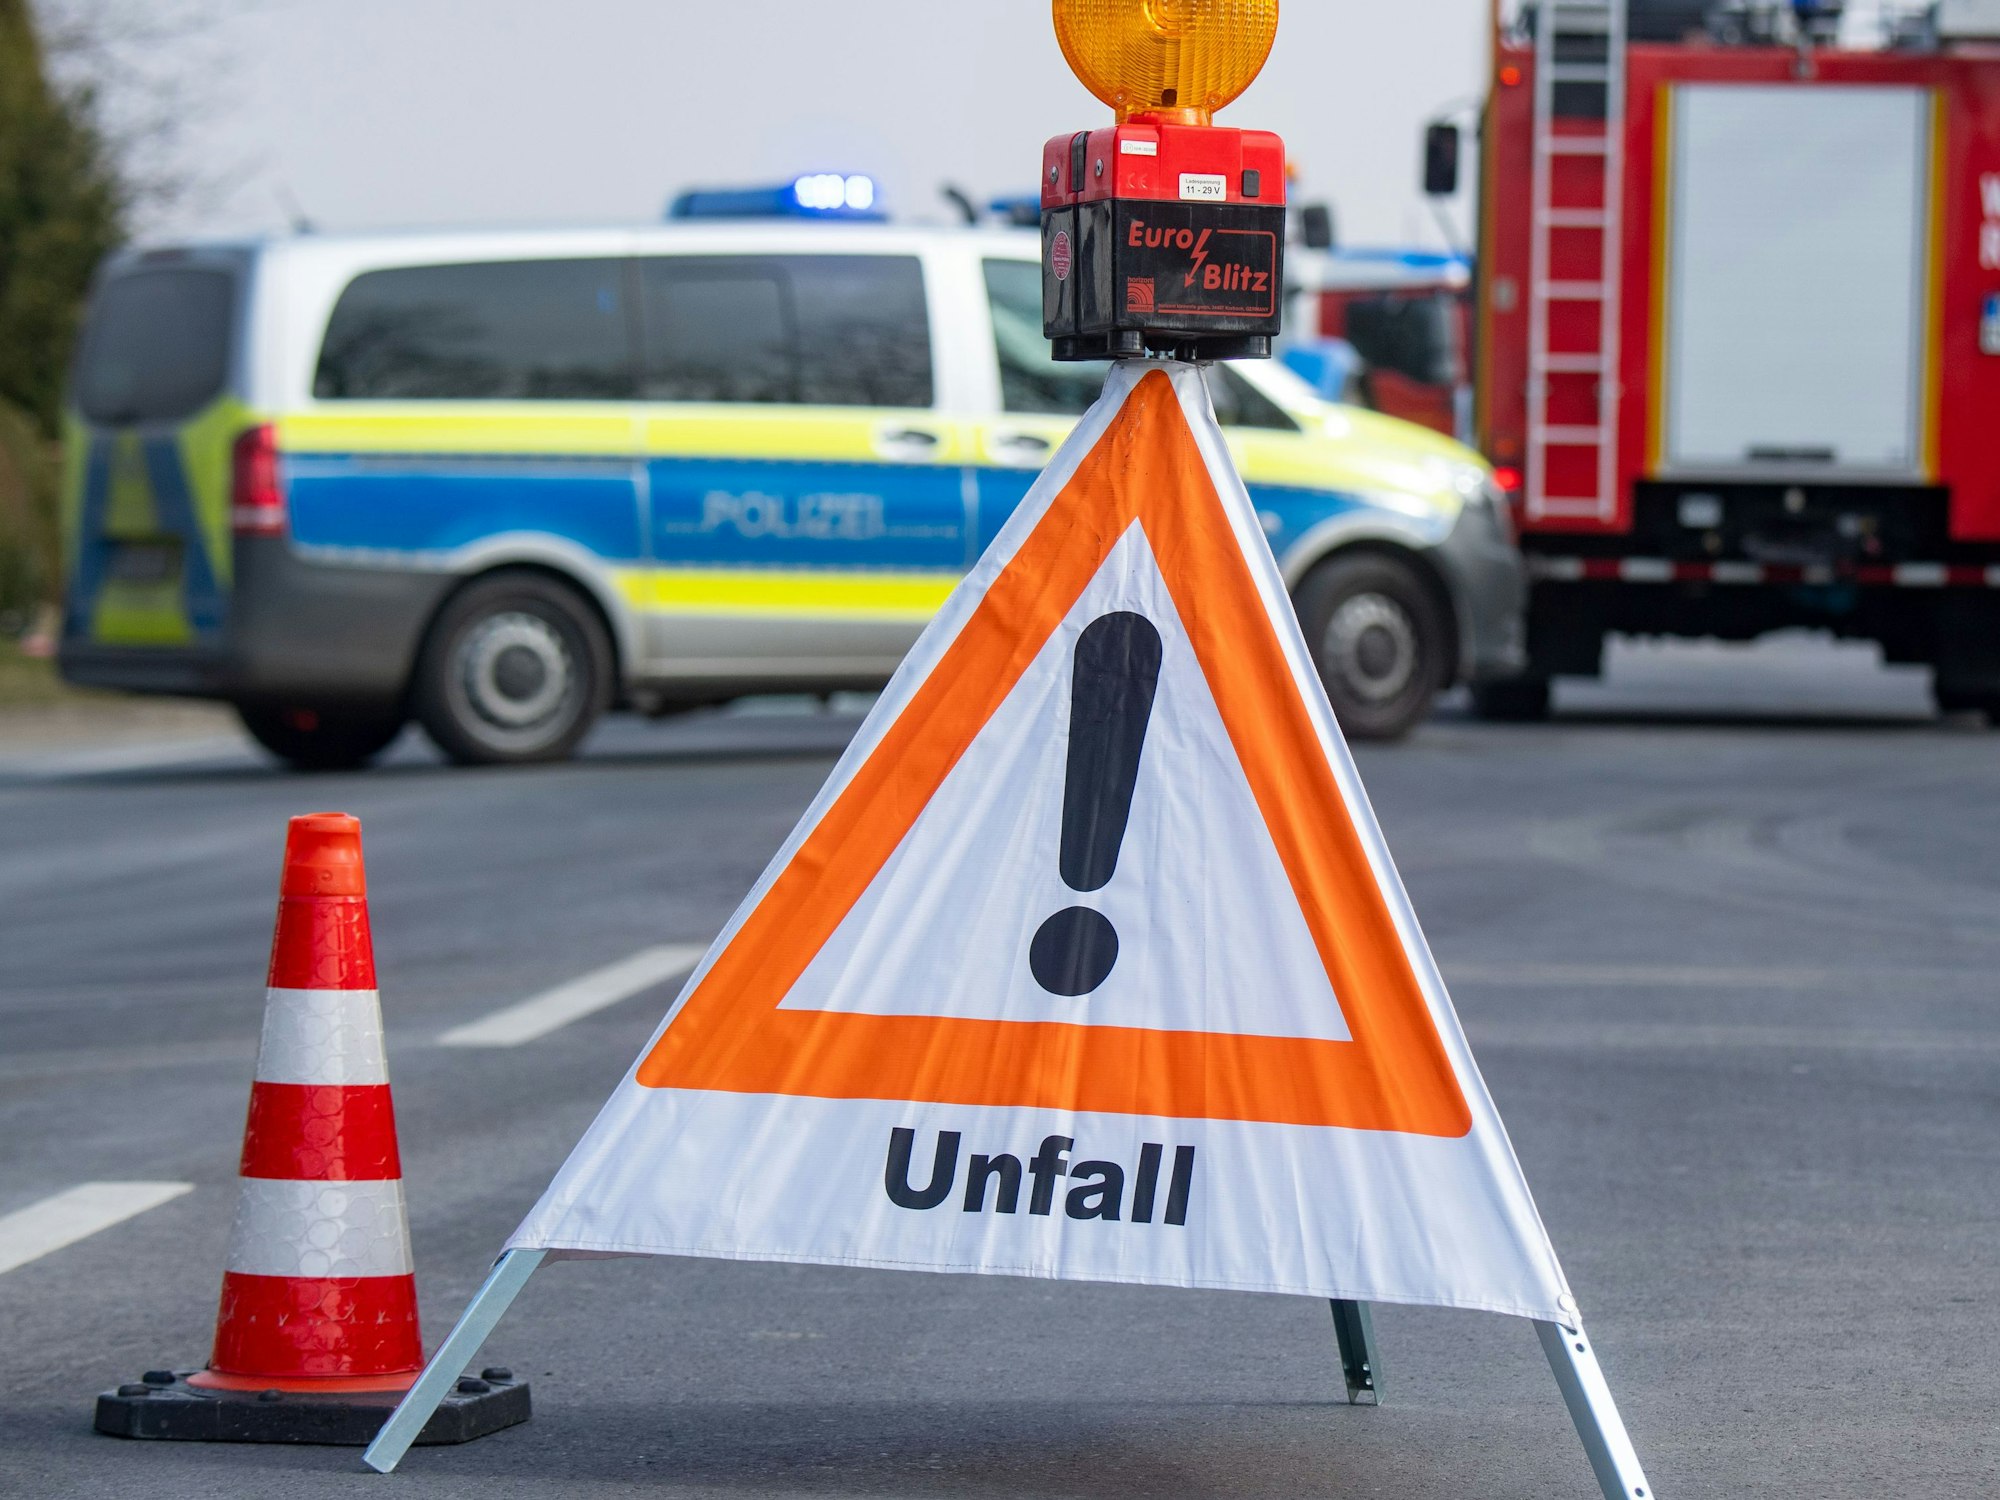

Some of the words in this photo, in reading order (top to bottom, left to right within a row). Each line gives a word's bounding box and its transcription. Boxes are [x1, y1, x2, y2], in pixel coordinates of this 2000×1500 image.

[1186, 185, 1195, 194] 11
[1202, 186, 1213, 195] 29
[1214, 186, 1221, 195] V
[1128, 220, 1194, 249] Euro
[1203, 263, 1269, 292] Blitz
[703, 489, 885, 540] POLIZEI
[885, 1127, 1195, 1226] Unfall
